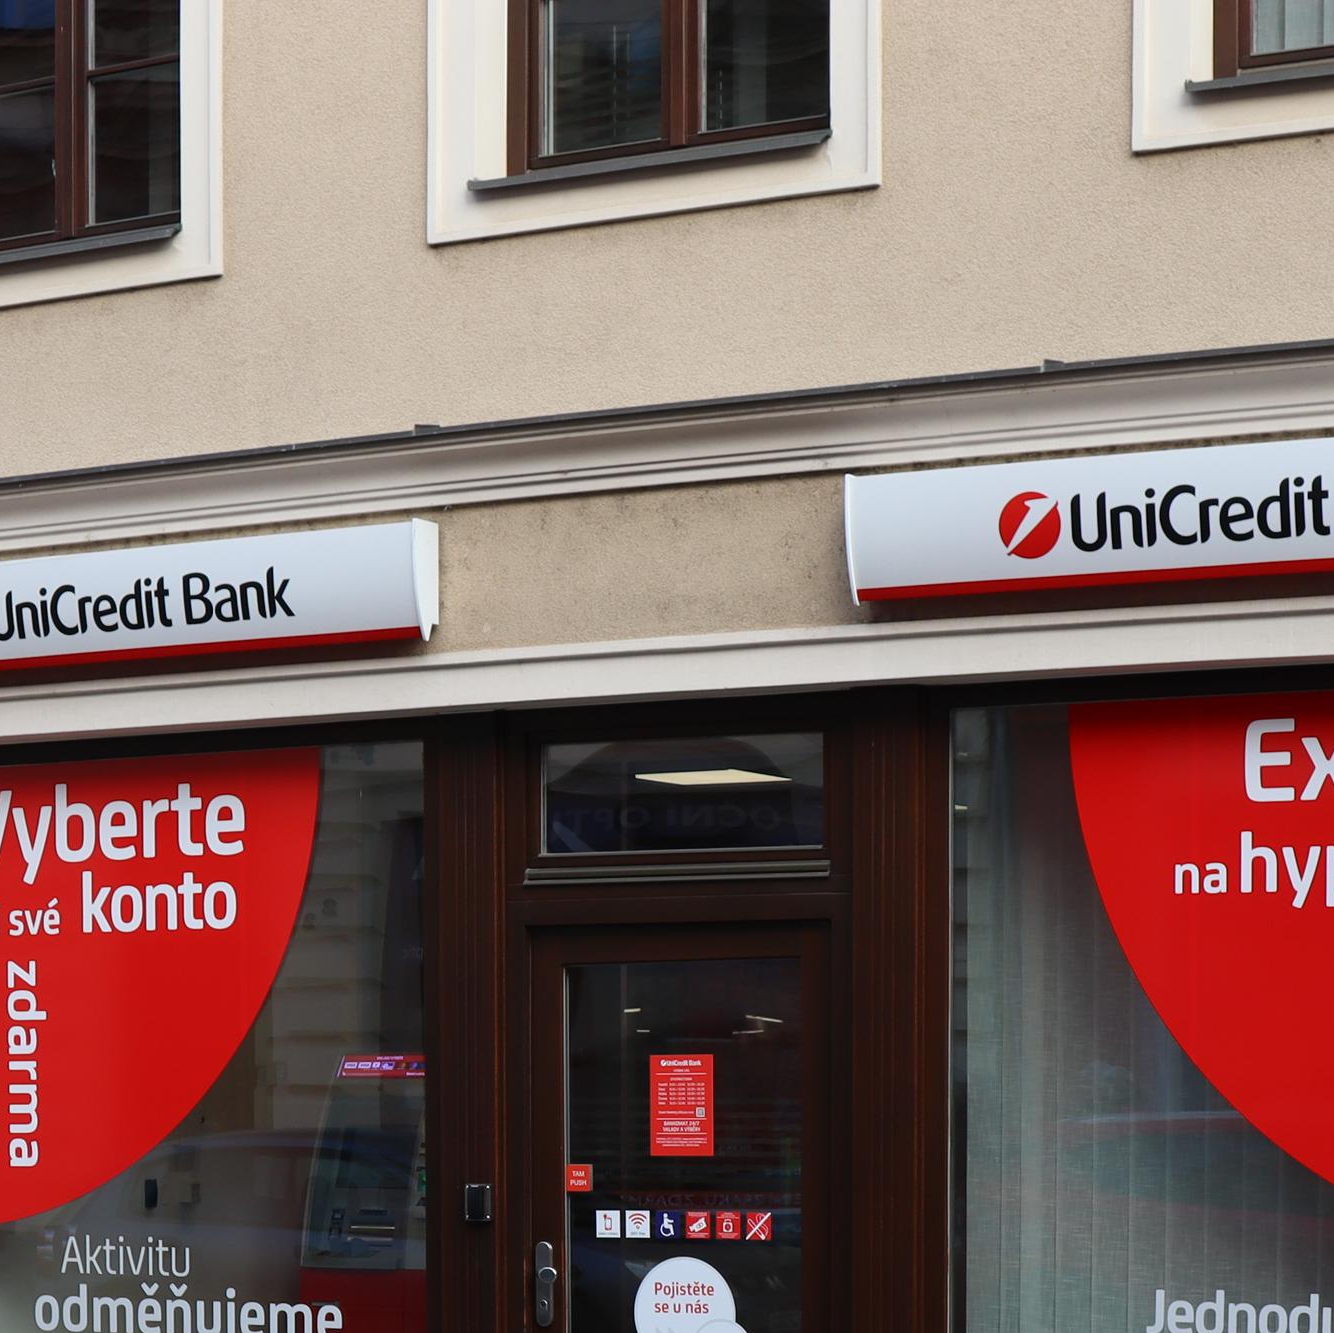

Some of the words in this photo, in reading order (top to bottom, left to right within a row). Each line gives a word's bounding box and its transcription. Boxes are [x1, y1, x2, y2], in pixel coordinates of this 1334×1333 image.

[1069, 473, 1332, 553] UniCredit
[182, 565, 296, 626] Bank
[9, 897, 61, 937] své
[81, 870, 238, 934] konto
[1174, 861, 1228, 895] na
[6, 959, 48, 1168] zdarma
[61, 1234, 191, 1278] Aktivitu
[654, 1281, 715, 1299] Pojistěte
[654, 1302, 669, 1313] se
[673, 1302, 681, 1313] u
[685, 1299, 709, 1314] nás
